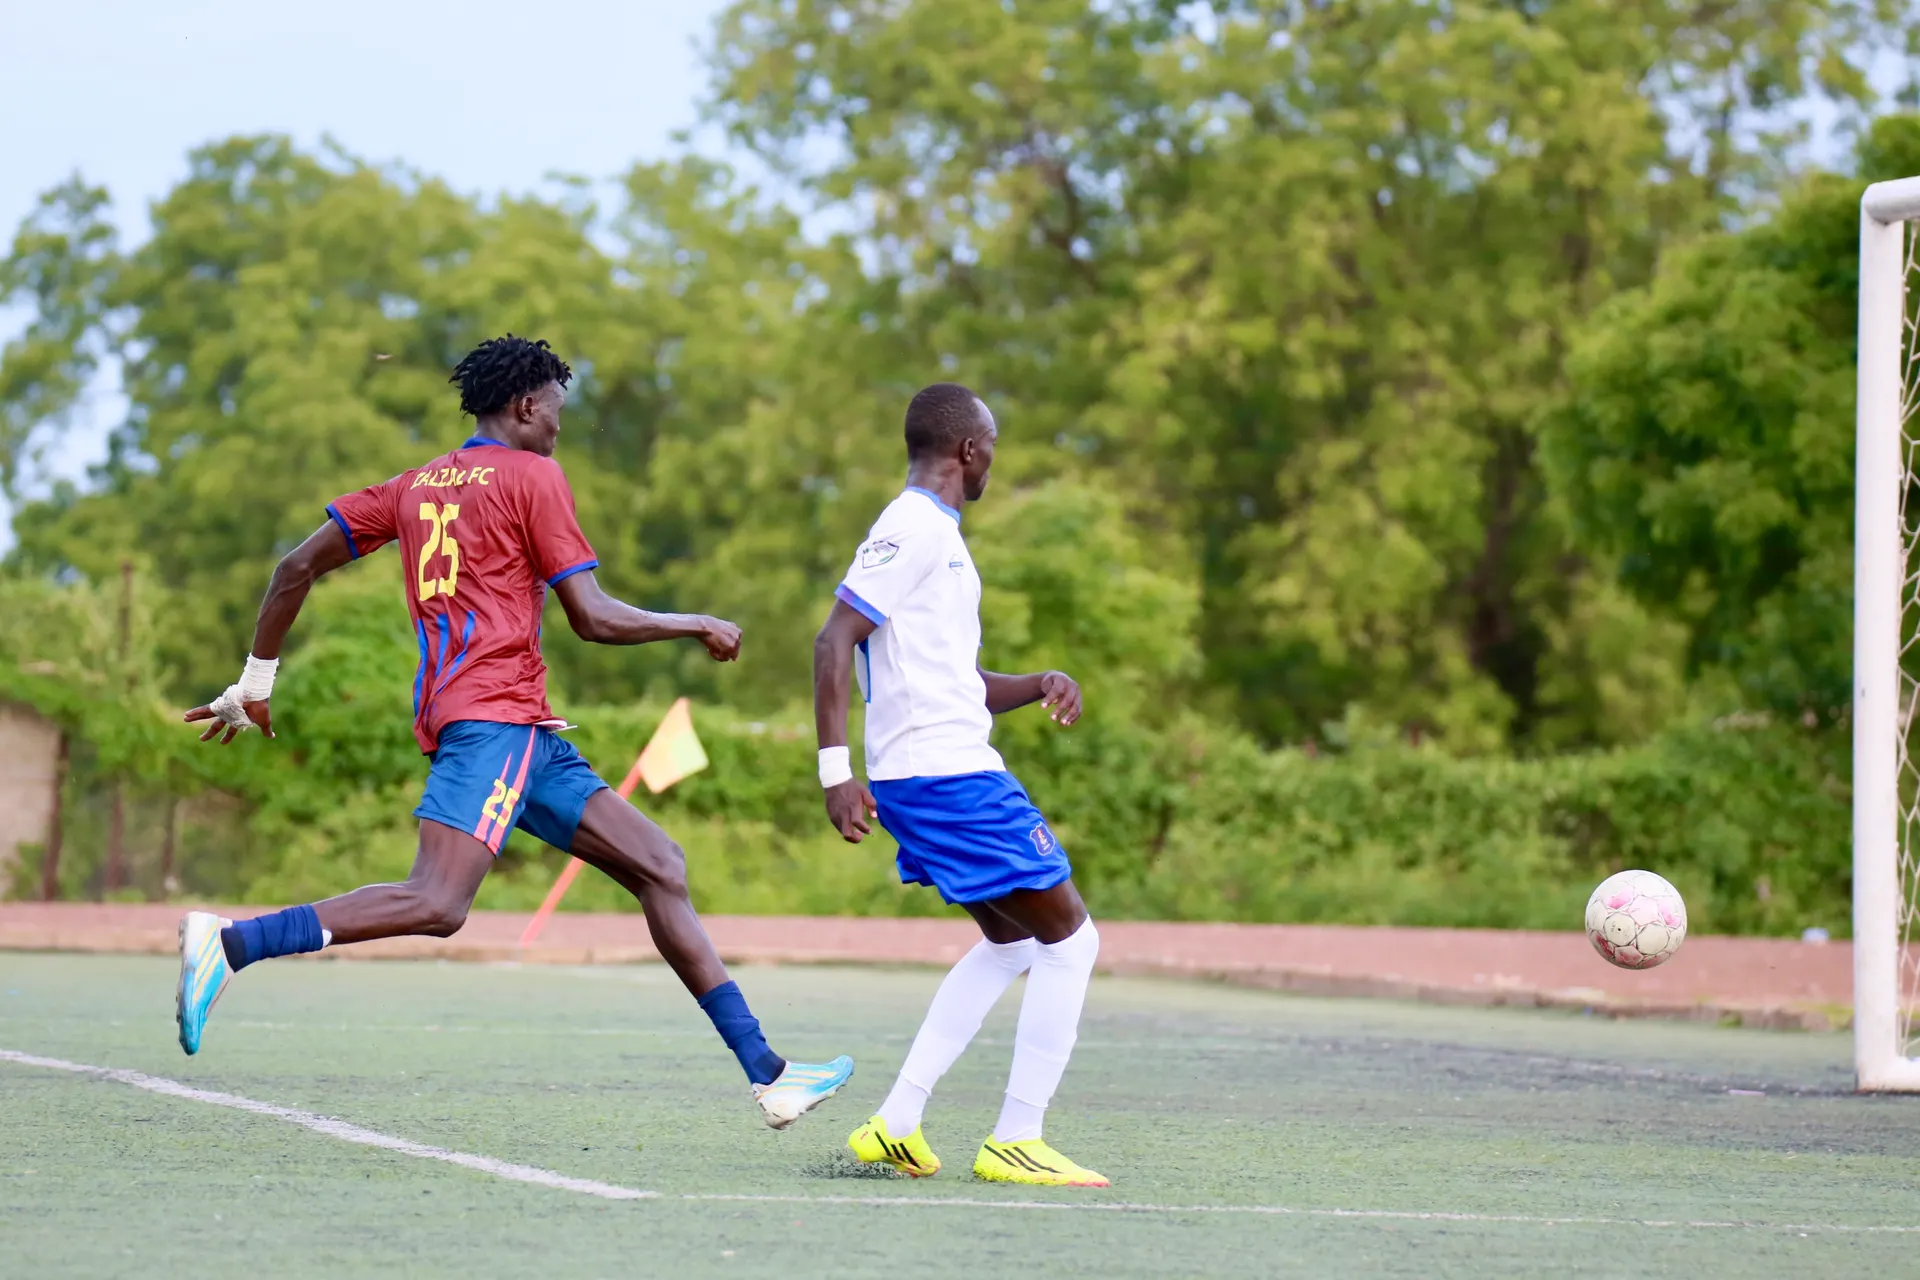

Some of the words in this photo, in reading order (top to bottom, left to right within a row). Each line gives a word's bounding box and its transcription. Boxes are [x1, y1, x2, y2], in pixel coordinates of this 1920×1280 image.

[467, 466, 495, 486] FC
[418, 502, 460, 601] 25
[482, 778, 520, 828] 25
